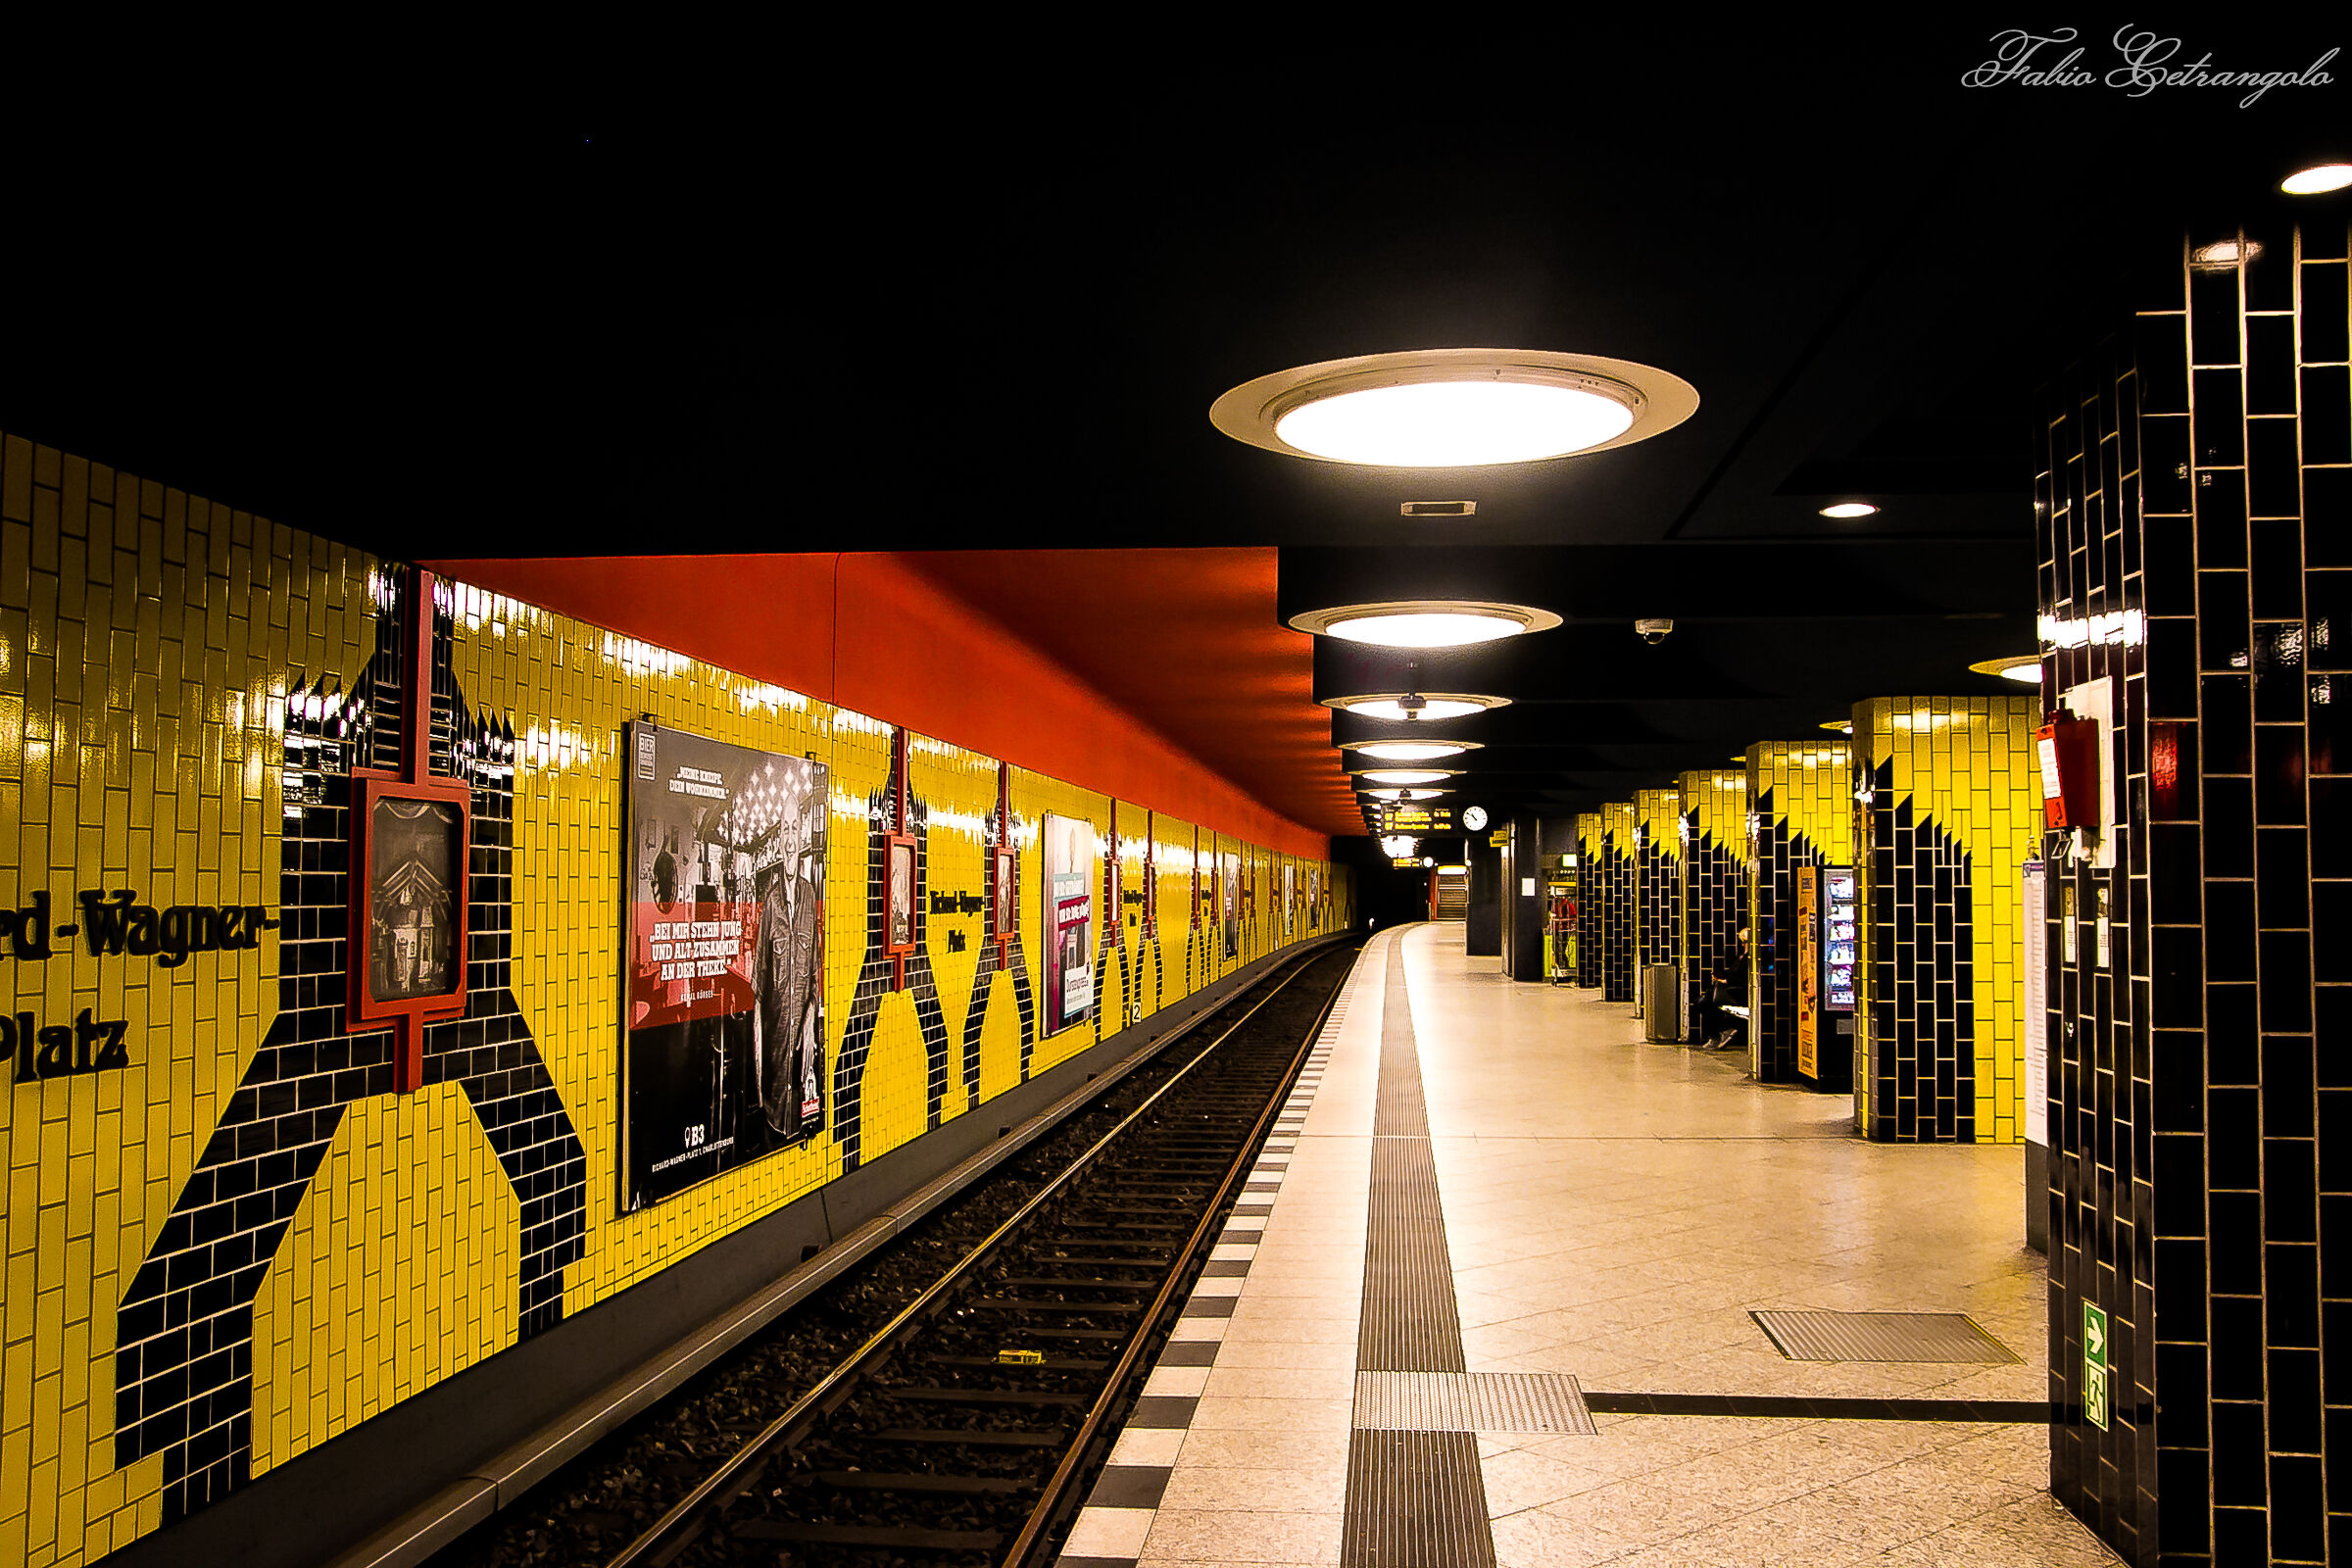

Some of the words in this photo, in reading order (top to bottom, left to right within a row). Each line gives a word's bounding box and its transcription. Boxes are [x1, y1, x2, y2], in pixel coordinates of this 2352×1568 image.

[640, 737, 654, 753] BIER
[672, 922, 689, 939] MIR
[691, 921, 719, 938] STEHN
[721, 920, 742, 940] JUNG
[652, 944, 672, 961] UND
[674, 942, 692, 959] ALT
[693, 940, 740, 957] ZUSAMMEN
[661, 963, 675, 981] AN
[676, 961, 695, 979] DER
[1134, 1004, 1141, 1020] 2
[691, 1124, 705, 1147] B3
